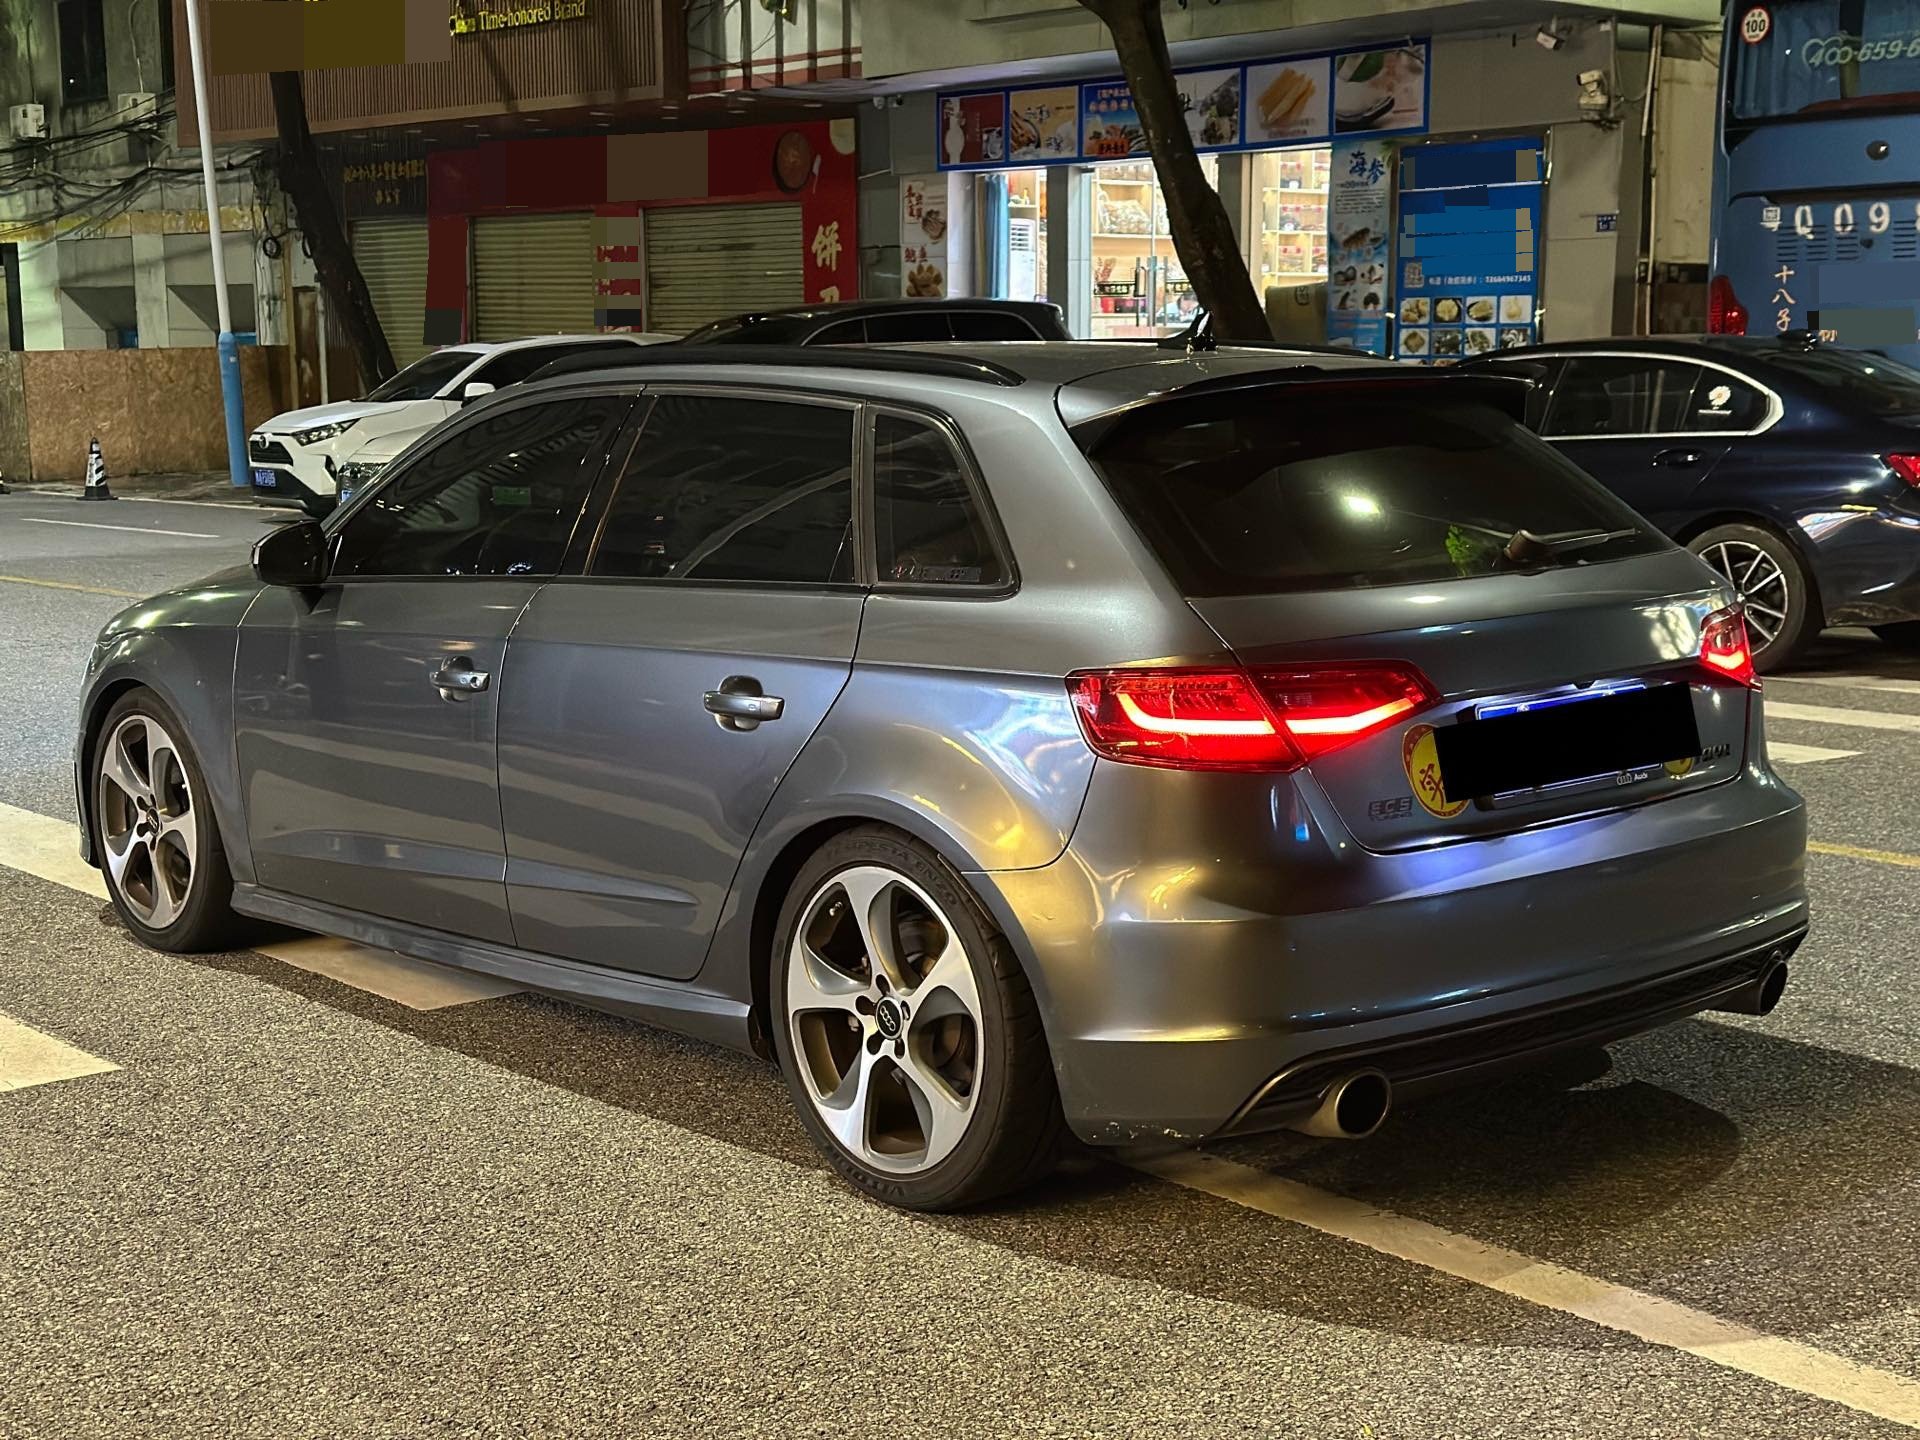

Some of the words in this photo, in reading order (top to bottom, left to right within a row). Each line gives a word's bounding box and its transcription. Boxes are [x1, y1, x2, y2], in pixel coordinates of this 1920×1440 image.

[478, 4, 551, 31] Time-honored
[554, 0, 585, 20] Brand
[1745, 19, 1766, 33] 100
[1760, 201, 1920, 239] 粤Q09
[1772, 265, 1796, 331] 十八子
